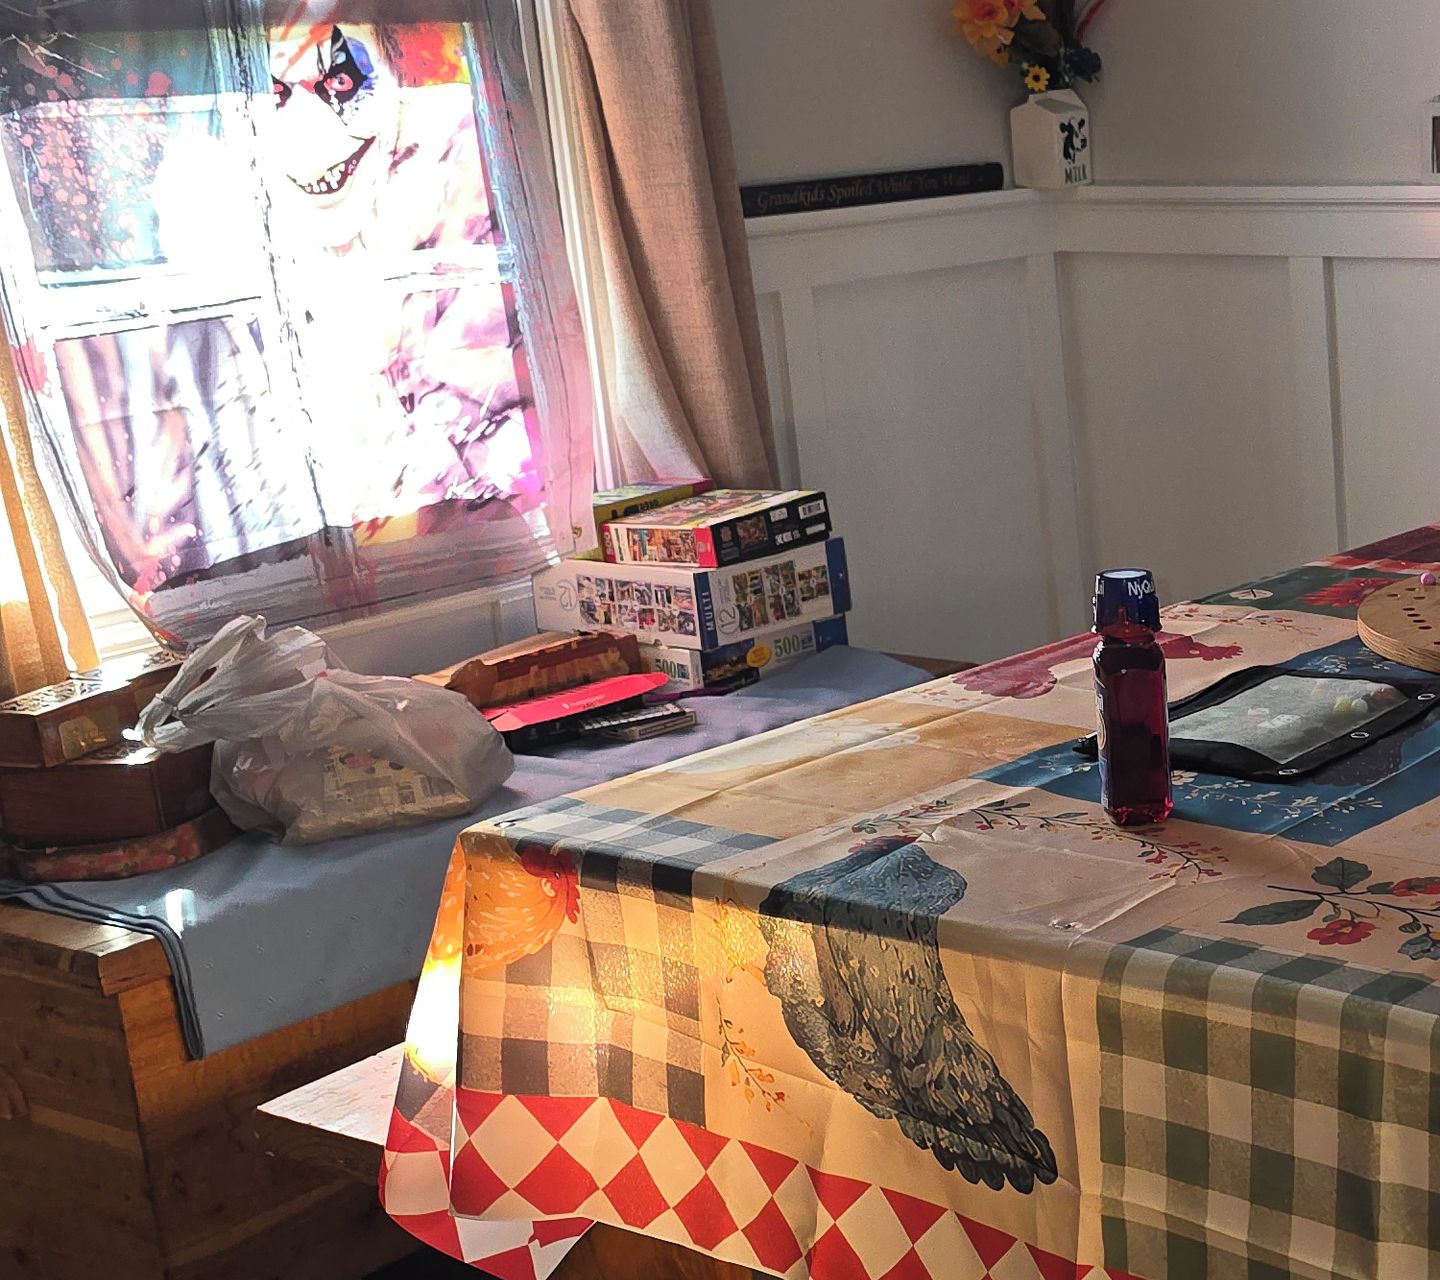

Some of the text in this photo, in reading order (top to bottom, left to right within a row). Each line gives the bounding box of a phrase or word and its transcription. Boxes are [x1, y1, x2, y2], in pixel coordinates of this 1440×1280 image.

[1065, 164, 1088, 184] MILK
[757, 184, 825, 213] Grandkids
[827, 177, 873, 205] Spoiled
[701, 591, 715, 631] MULTI
[718, 606, 736, 628] 12
[774, 635, 800, 657] 500
